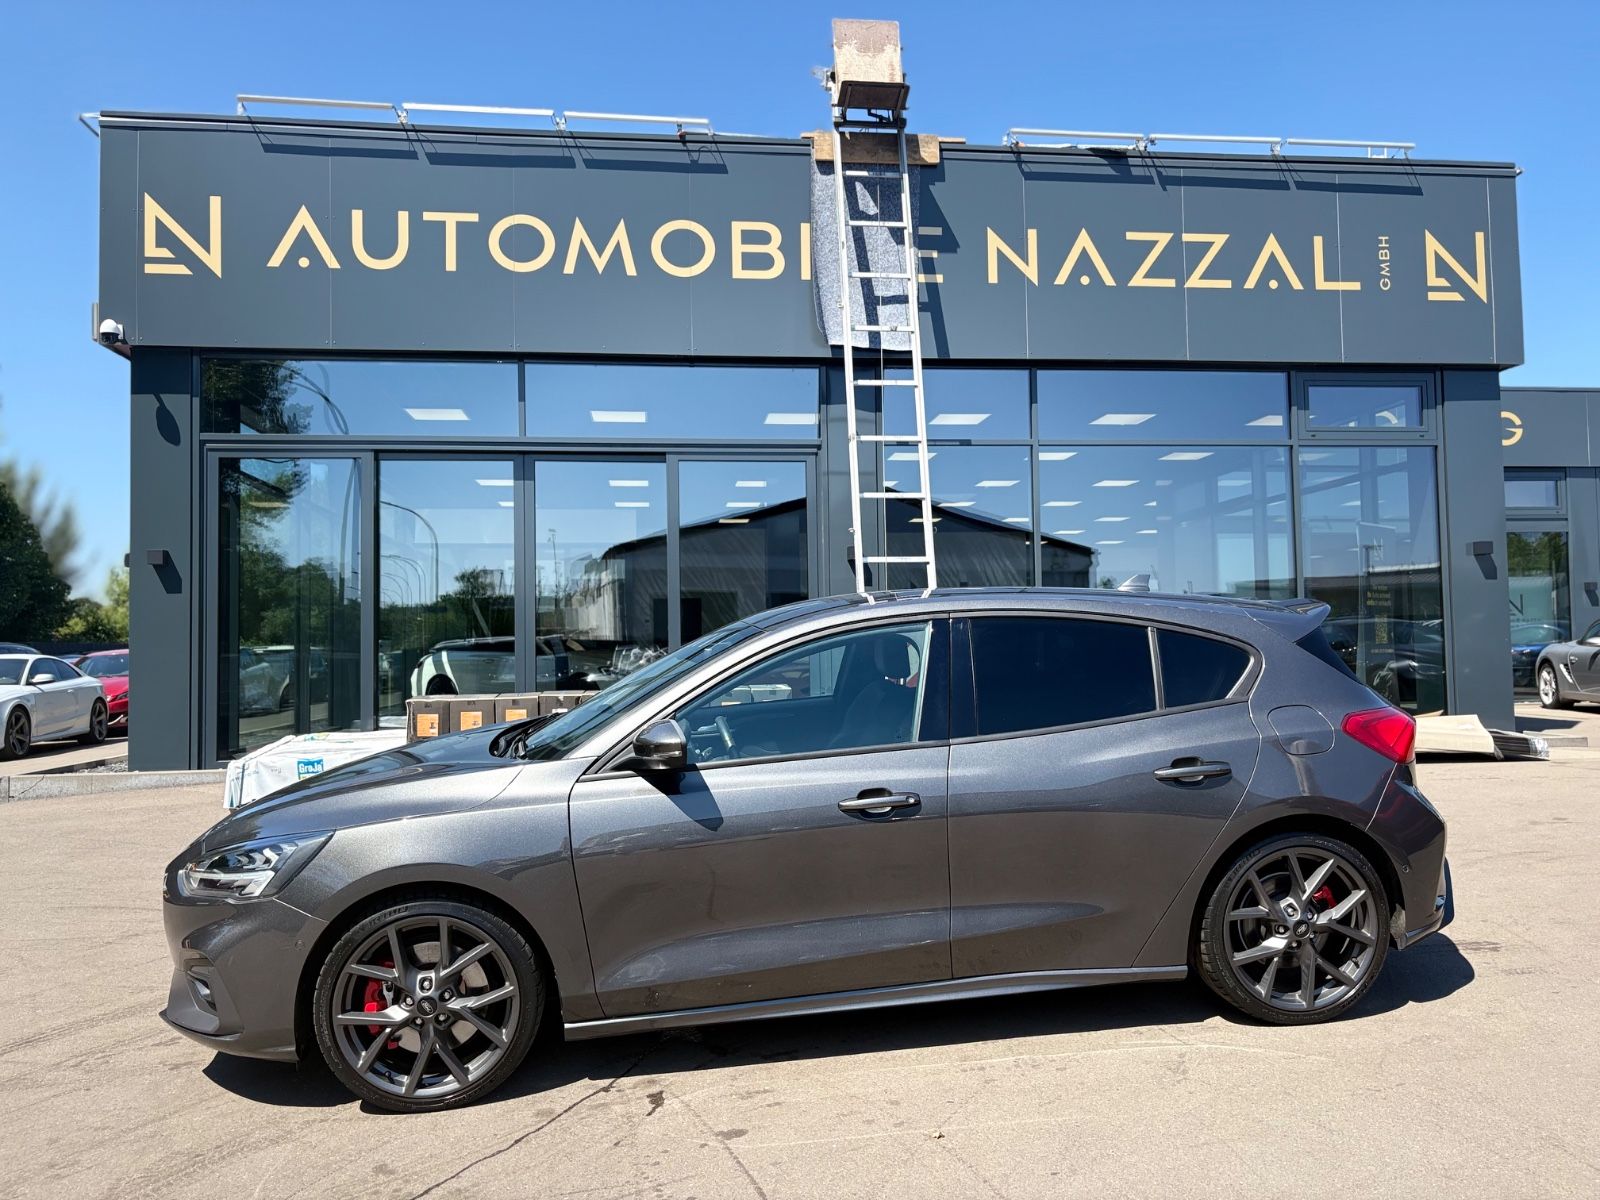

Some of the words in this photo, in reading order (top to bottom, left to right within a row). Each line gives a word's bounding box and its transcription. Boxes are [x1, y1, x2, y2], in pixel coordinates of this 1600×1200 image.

[266, 204, 944, 284] AUTOMOBIE
[986, 226, 1362, 292] NAZZAL
[1378, 235, 1391, 291] GMBH
